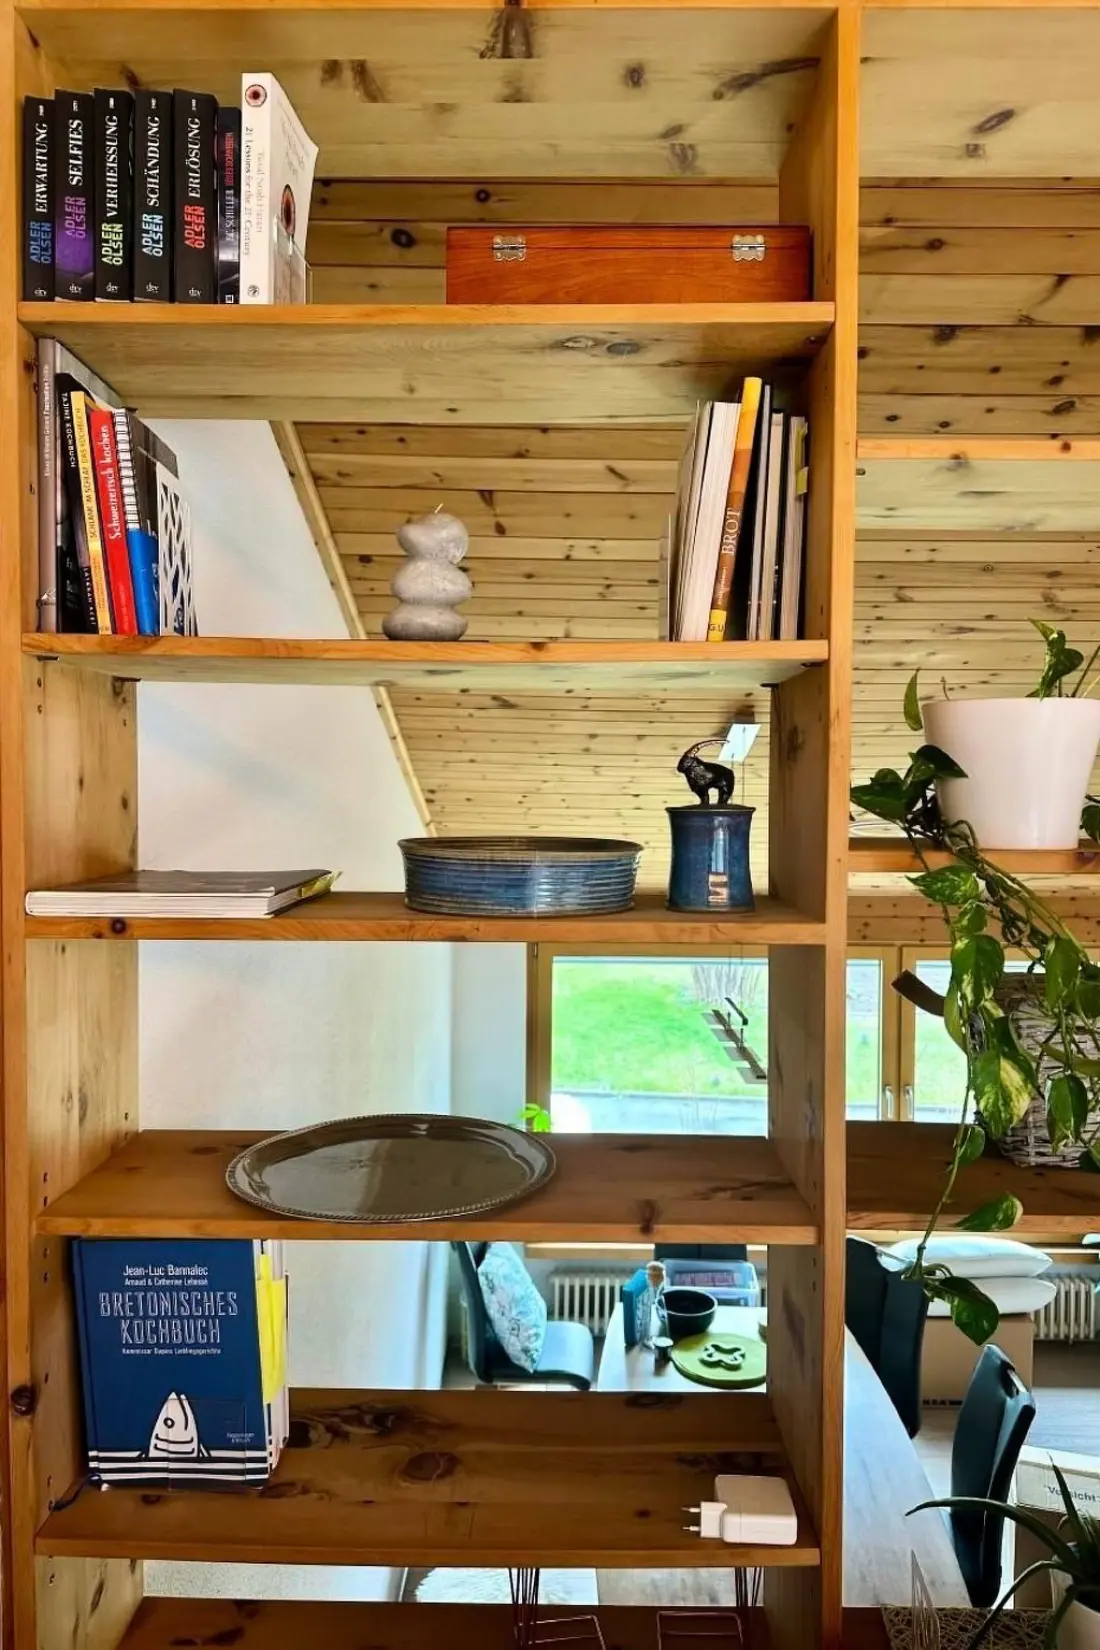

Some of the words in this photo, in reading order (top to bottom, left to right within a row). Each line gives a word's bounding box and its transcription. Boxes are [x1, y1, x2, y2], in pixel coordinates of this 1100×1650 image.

[69, 119, 83, 186] SELFIES
[245, 127, 253, 136] 21
[35, 122, 48, 214] ERWARTUNG
[105, 115, 118, 218] VERHEISSUNG
[144, 116, 160, 207] SCHÄNDUNG
[185, 117, 200, 198] ERLÖSUNG
[245, 139, 253, 174] Lessons
[244, 174, 253, 187] for
[244, 189, 253, 204] the
[64, 195, 75, 237] ADLER
[75, 197, 86, 239] OLSEN
[142, 213, 153, 256] ADLER
[153, 214, 163, 257] OLSEN
[184, 204, 195, 248] ADLER
[194, 206, 205, 249] OLSEN
[30, 220, 41, 263] ADLER
[41, 222, 52, 264] OLSEN
[102, 222, 113, 264] ADLER
[112, 223, 123, 265] OLSEN
[243, 219, 252, 256] Century
[61, 392, 71, 421] TAJINE
[64, 423, 76, 468] KOCHBUCH
[99, 424, 111, 464] kochen
[105, 466, 121, 540] Schweizerisch
[721, 507, 741, 557] BROT
[123, 1264, 165, 1276] Jean-Luc
[167, 1263, 209, 1276] Bannalec
[99, 1291, 239, 1318] BRETONISCHES
[120, 1318, 221, 1345] KOCHBUCH
